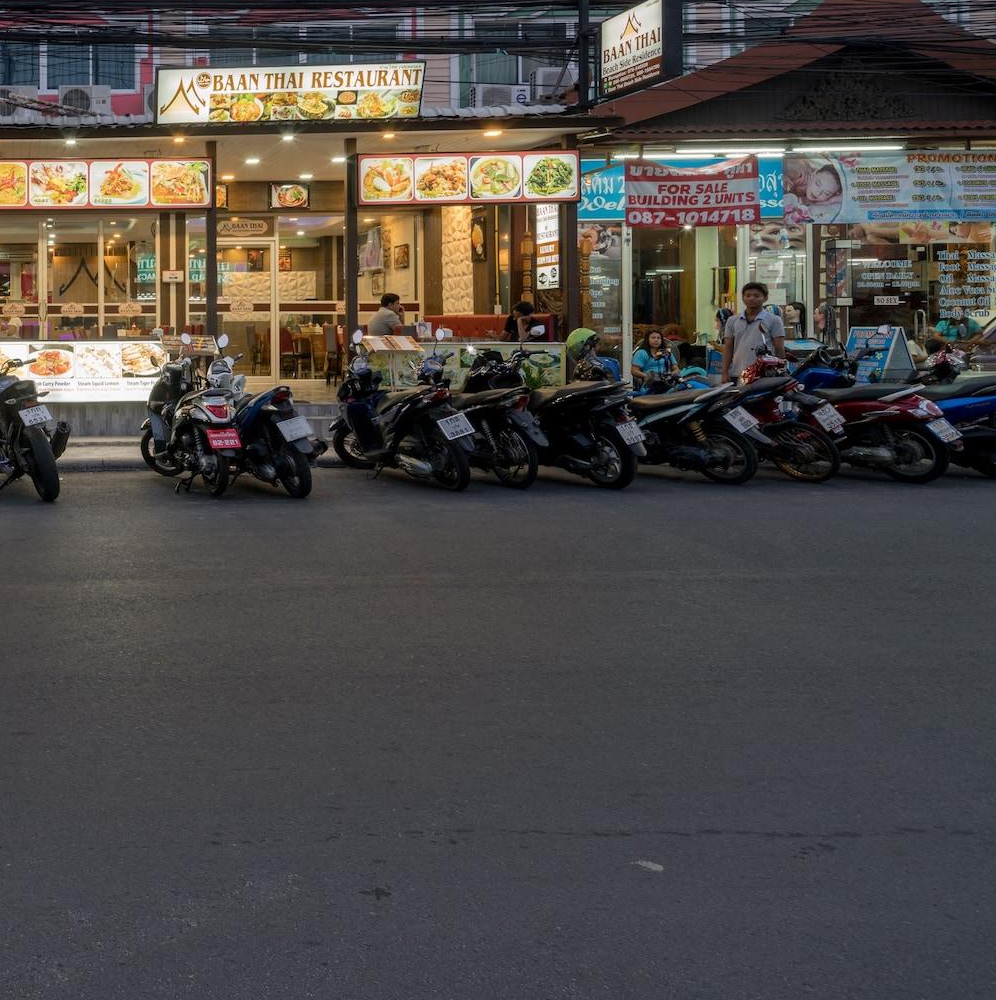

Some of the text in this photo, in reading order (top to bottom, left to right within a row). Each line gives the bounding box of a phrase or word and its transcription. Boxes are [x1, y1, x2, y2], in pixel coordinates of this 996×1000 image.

[603, 27, 661, 64] BAAN THAI
[603, 63, 618, 75] Beach
[619, 58, 631, 69] Side
[632, 47, 661, 64] Residence
[211, 68, 423, 92] BAAN THAI RESTAURANT
[657, 183, 728, 195] FOR SALE
[628, 191, 756, 207] BUILDING 2 UNITS
[628, 209, 755, 224] 087-1014718
[937, 250, 959, 260] Thai
[861, 260, 913, 268] WELCOME
[939, 263, 961, 271] Foot
[860, 272, 915, 280] OPEN DAILY
[939, 274, 954, 283] Oil
[939, 286, 962, 295] Aloe
[963, 286, 985, 295] Vera
[939, 296, 990, 306] Coconut Oil
[940, 308, 989, 319] Body Scrub
